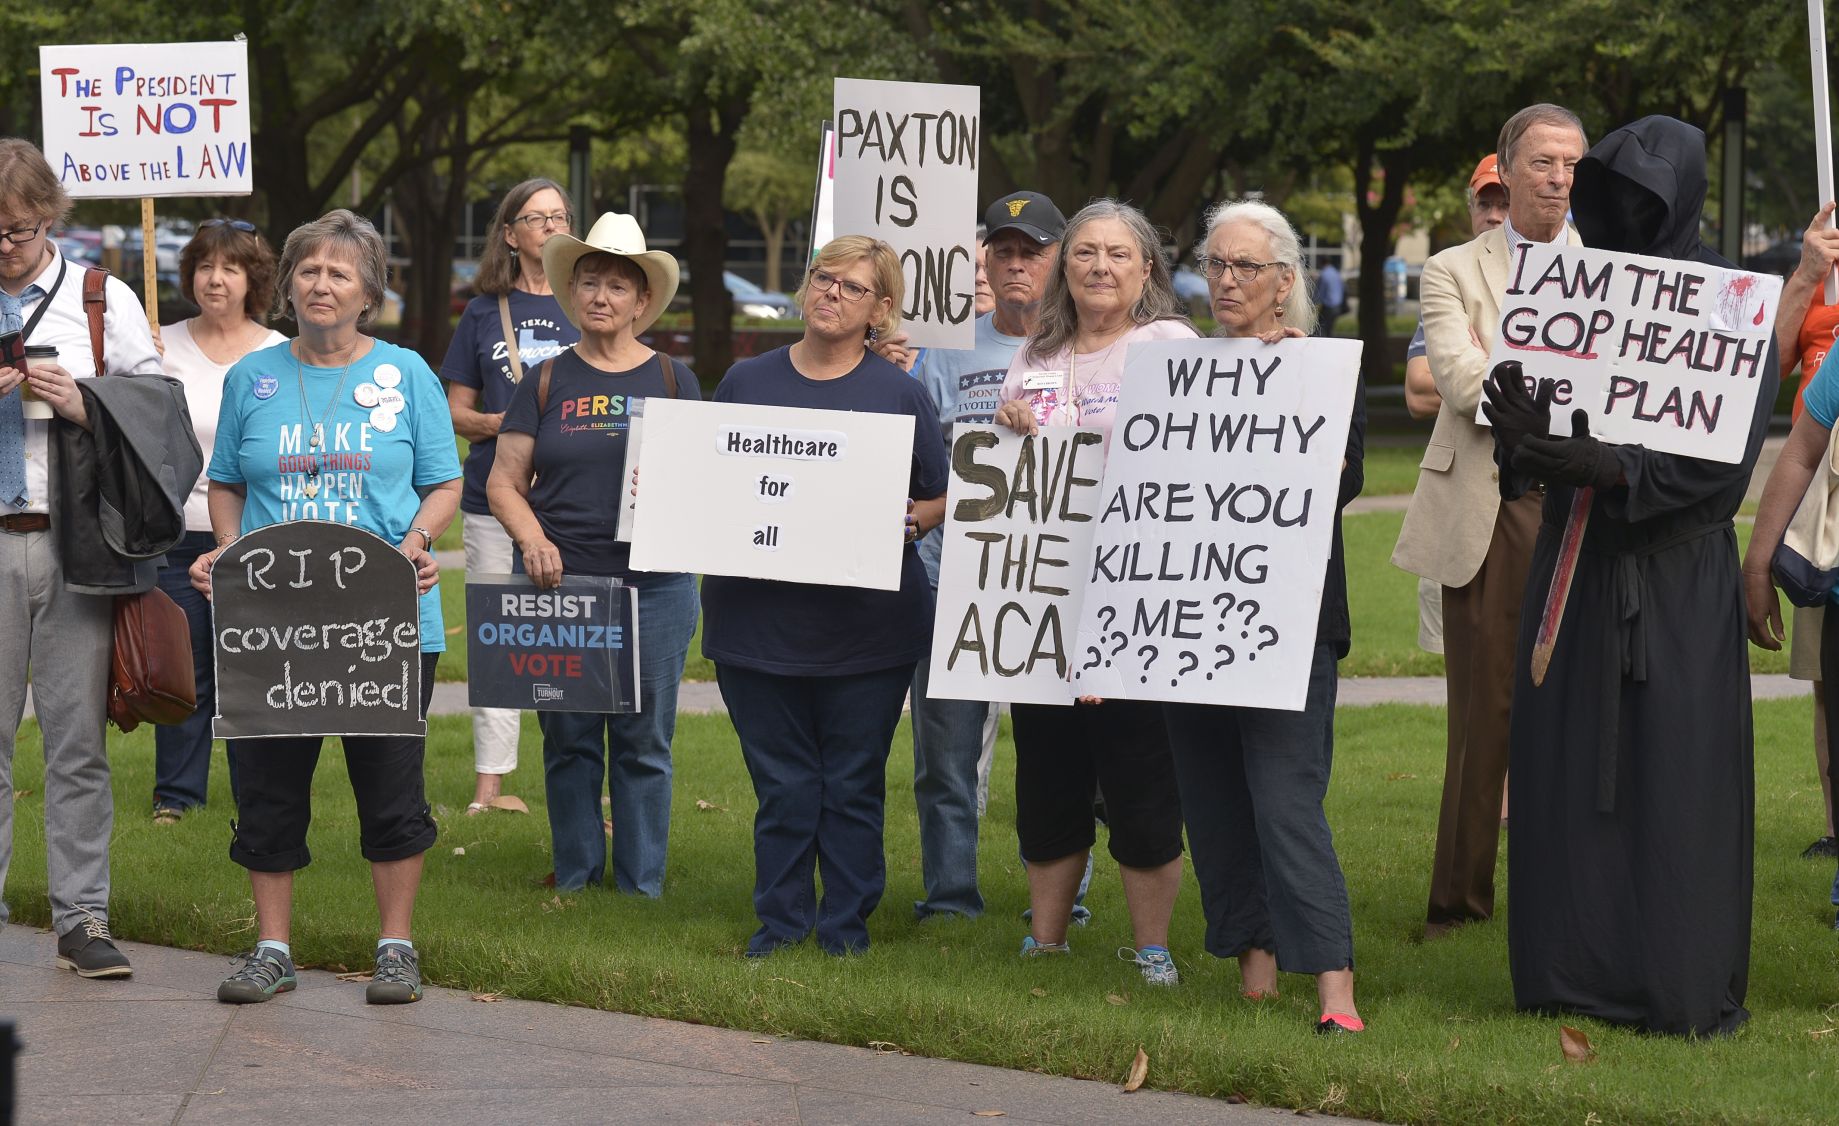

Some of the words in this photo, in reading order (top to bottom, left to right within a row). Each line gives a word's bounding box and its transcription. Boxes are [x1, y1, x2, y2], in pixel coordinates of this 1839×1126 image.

[51, 68, 101, 97] THE
[116, 67, 236, 97] PRESIDENT
[79, 106, 118, 136] IS
[136, 99, 237, 135] NOT
[838, 109, 977, 170] PAXTON
[61, 152, 130, 182] ABOVE
[139, 162, 171, 181] THE
[177, 141, 246, 179] LAW
[875, 174, 918, 227] IS
[901, 245, 975, 326] ONG
[1506, 243, 1534, 295] I
[1529, 253, 1613, 302] AM
[1624, 263, 1705, 317] THE
[521, 318, 554, 328] TEXAS
[1501, 307, 1615, 356] GOP
[1619, 319, 1766, 378] HEALTH
[1167, 356, 1282, 397] WHY
[561, 395, 632, 420] PERSI
[1604, 375, 1723, 434] PLAN
[279, 422, 373, 454] MAKE
[727, 432, 837, 457] Healthcare
[279, 455, 317, 474] GOOD
[322, 453, 372, 471] THINGS
[952, 430, 1103, 525] SAVE
[760, 475, 789, 498] for
[1101, 482, 1194, 524] ARE
[1205, 483, 1312, 528] YOU
[753, 526, 778, 547] all
[965, 532, 1070, 596] THE
[1091, 541, 1268, 585] KILLING
[502, 593, 596, 618] RESIST
[220, 617, 418, 662] coverage
[478, 622, 623, 649] ORGANIZE
[947, 601, 1067, 679] ACA
[267, 660, 409, 710] denied
[509, 652, 582, 678] VOTE
[537, 689, 564, 698] TURNOUT
